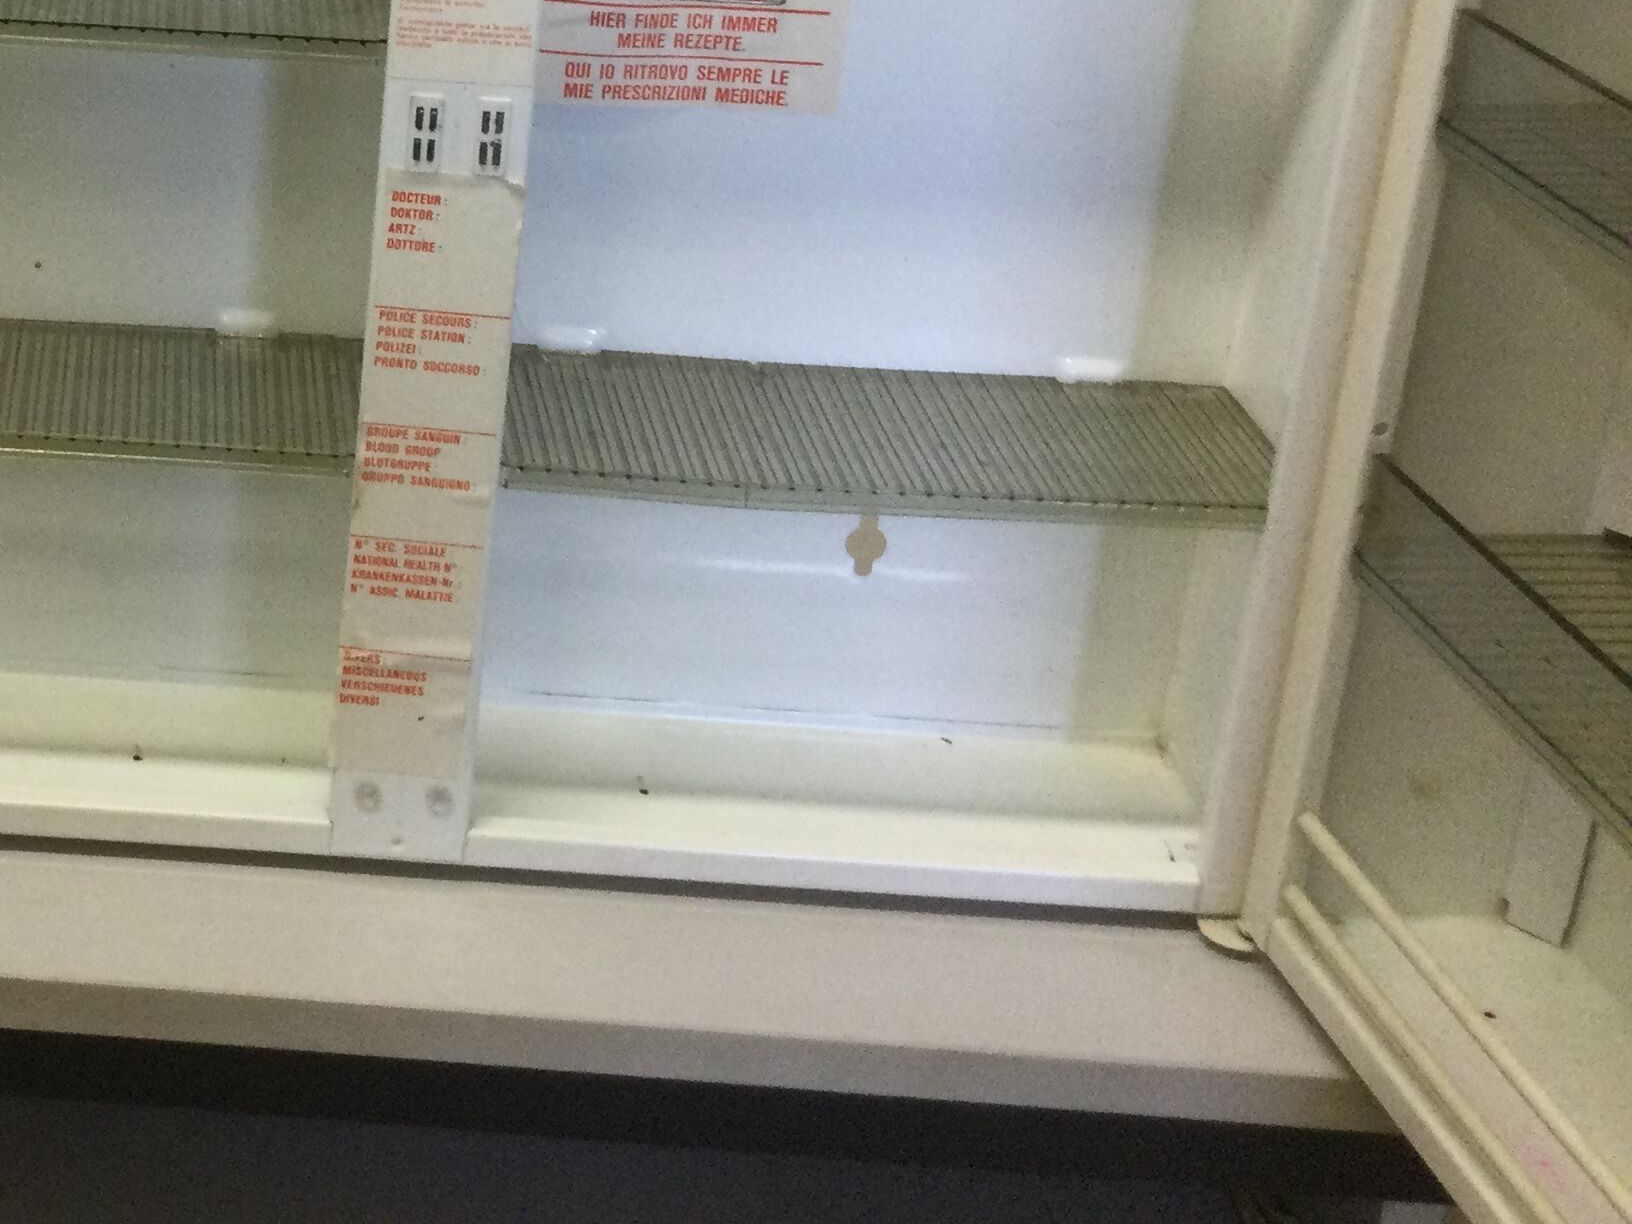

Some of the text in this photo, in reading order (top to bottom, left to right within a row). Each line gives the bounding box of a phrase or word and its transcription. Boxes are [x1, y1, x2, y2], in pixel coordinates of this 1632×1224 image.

[589, 11, 778, 33] HIER FINDE ICH IMMER
[617, 33, 665, 49] MEINE
[564, 62, 790, 85] QUI IO RITROVO SEMPRE LE
[563, 83, 593, 99] MIE
[601, 84, 706, 102] PRESCRIZIONI
[379, 310, 416, 323] POLICE
[377, 326, 414, 339] POLICE
[374, 356, 417, 370] PRONTO
[366, 426, 409, 440] GROUPE
[365, 441, 399, 454] BLOOD
[362, 471, 404, 485] GRUPPO
[353, 553, 400, 567] NATIONAL
[404, 557, 441, 571] HEALTH
